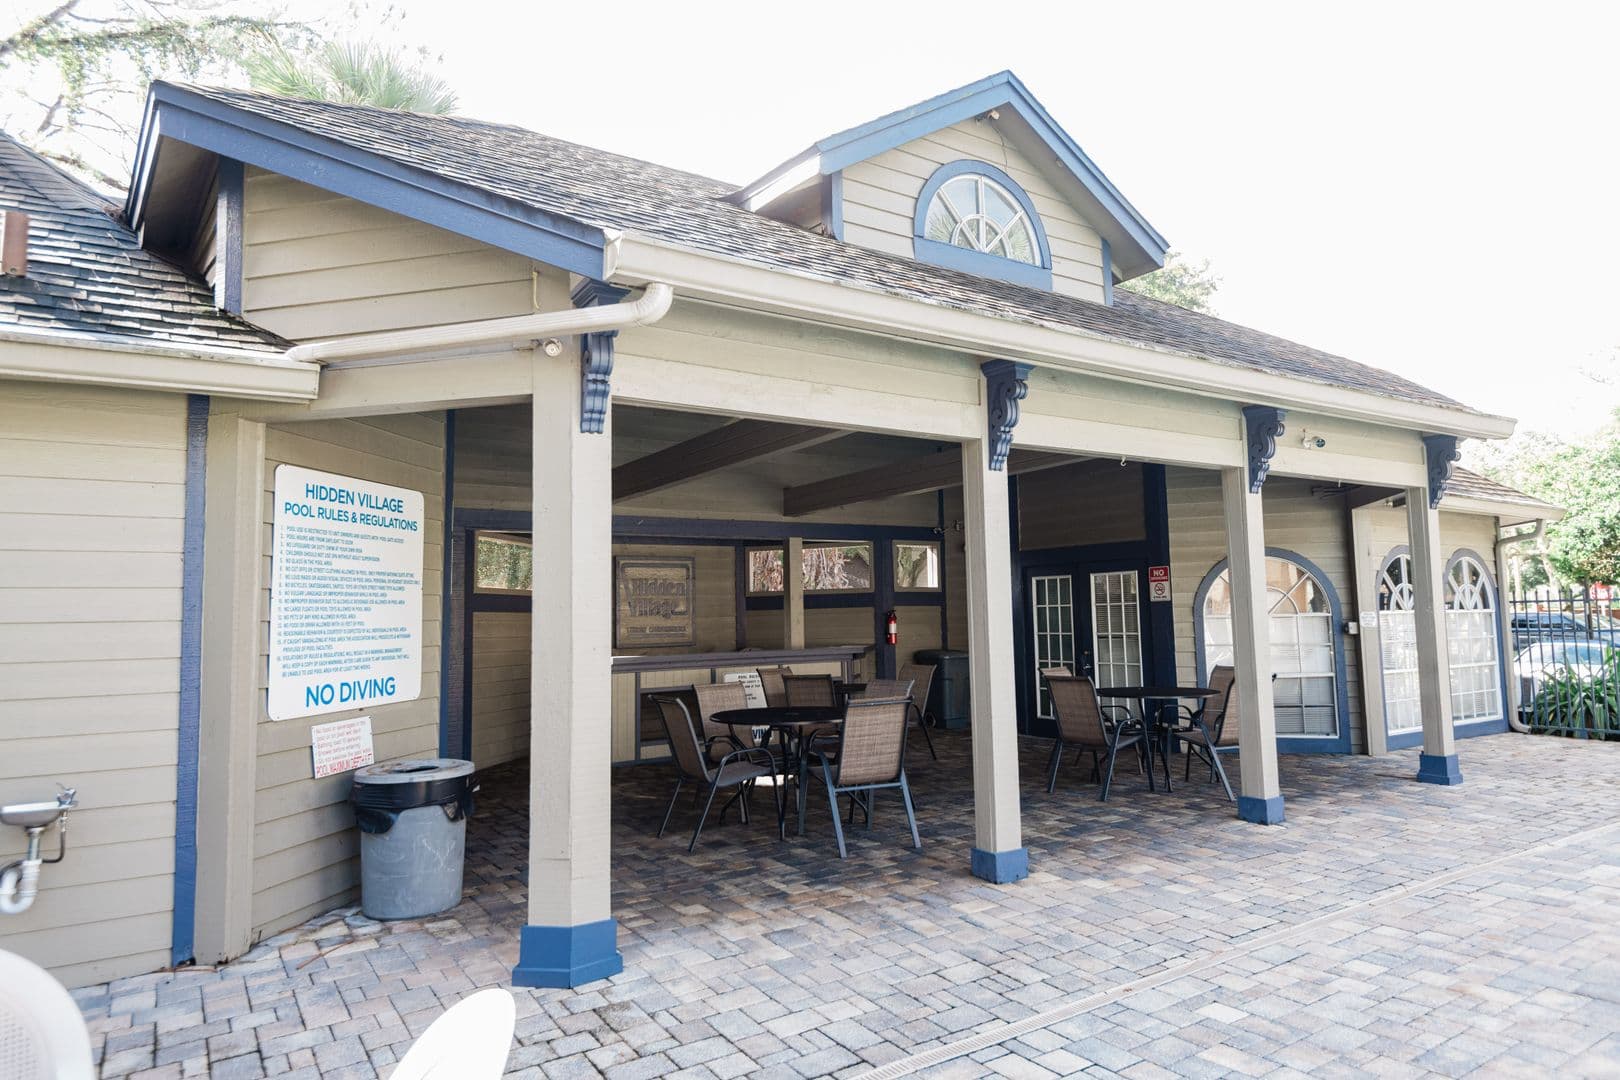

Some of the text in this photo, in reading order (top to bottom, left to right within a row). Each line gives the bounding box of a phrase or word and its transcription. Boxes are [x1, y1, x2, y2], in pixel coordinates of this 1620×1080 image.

[305, 483, 404, 513] HIDDEN VILLAGE
[284, 502, 418, 531] POOL RULES & REGULATIONS
[1153, 569, 1164, 577] NO
[305, 676, 396, 708] NO DIVING
